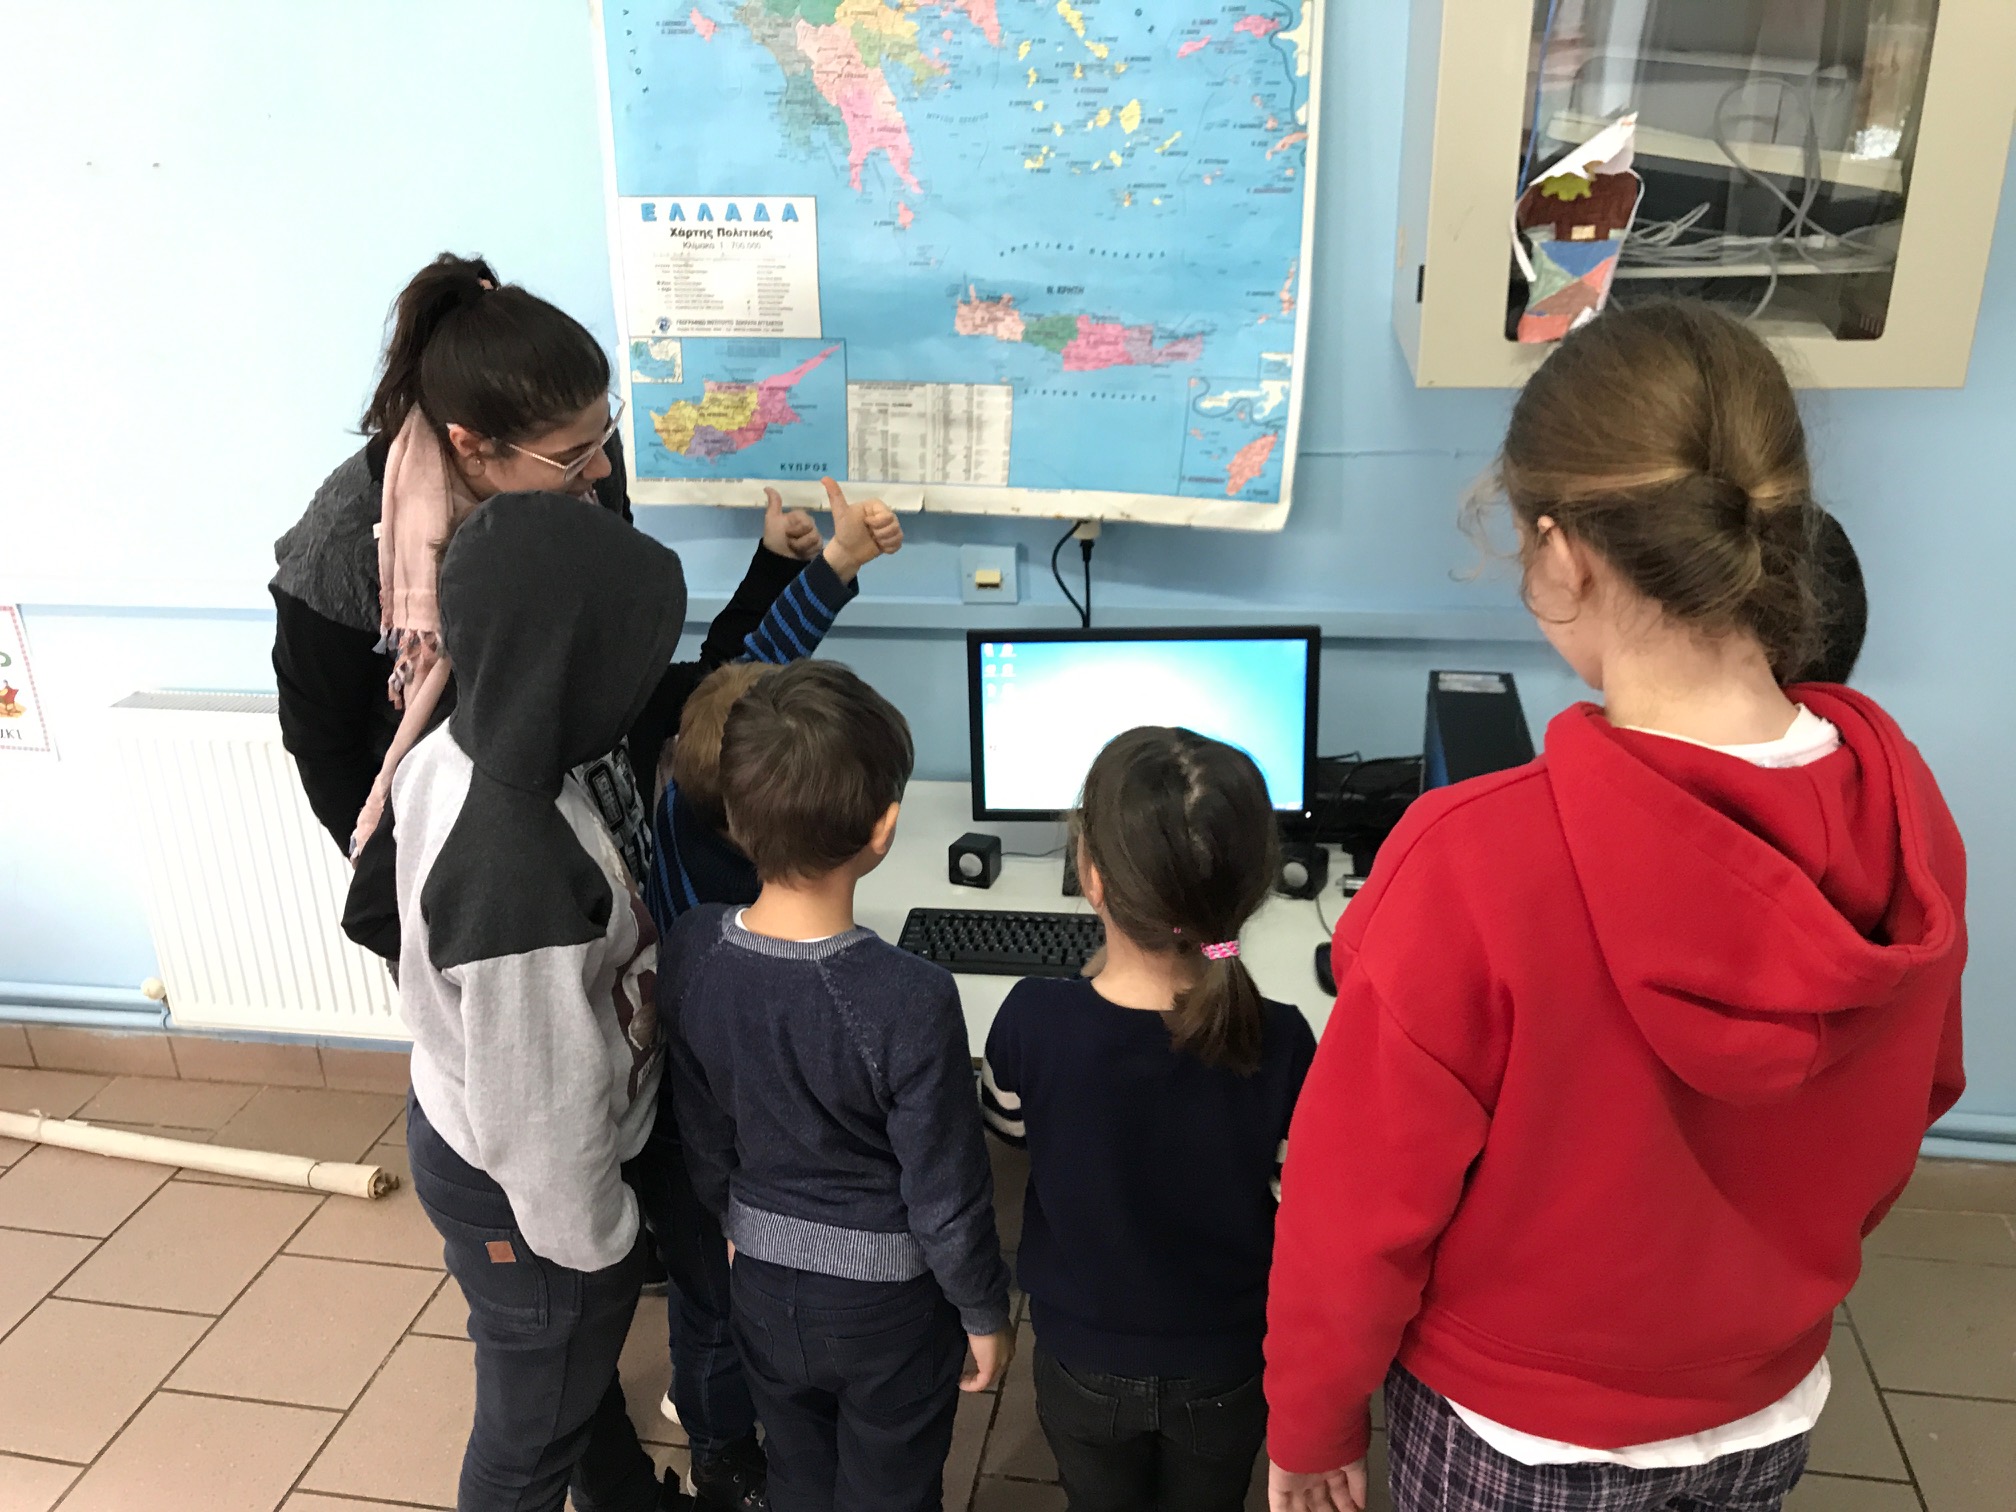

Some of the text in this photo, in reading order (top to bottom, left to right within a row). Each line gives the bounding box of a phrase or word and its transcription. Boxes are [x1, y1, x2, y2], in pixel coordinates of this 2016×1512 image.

[641, 203, 799, 222] ΕΛΛΑΔΑ
[669, 226, 773, 239] Χάρτης Πολιτικός
